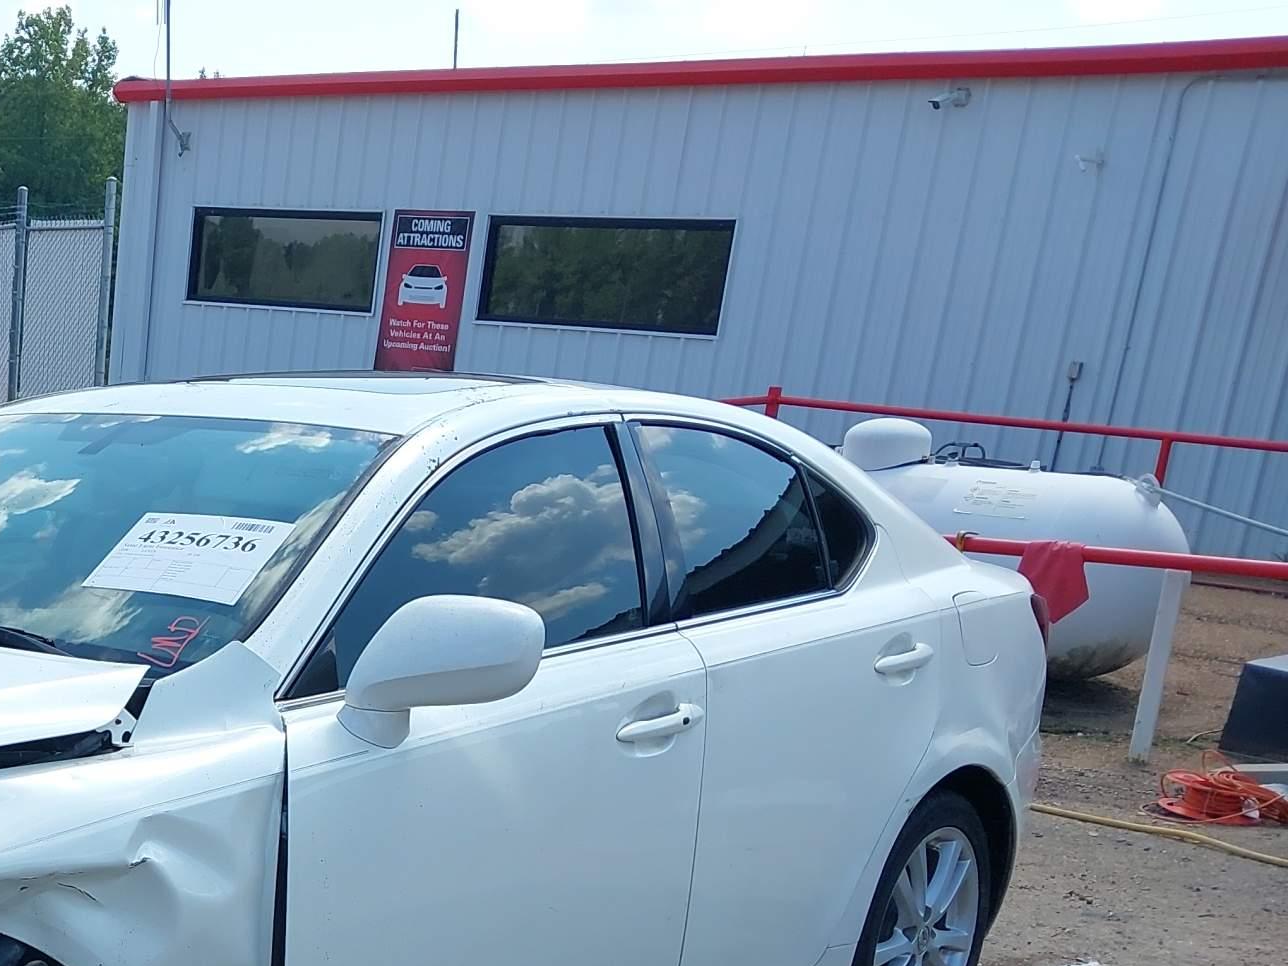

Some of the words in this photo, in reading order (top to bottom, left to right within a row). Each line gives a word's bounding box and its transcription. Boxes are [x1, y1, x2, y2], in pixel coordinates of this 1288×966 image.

[412, 219, 452, 233] COMING
[397, 233, 464, 247] ATTRACTIONS
[389, 318, 411, 327] Watch
[413, 320, 425, 328] For
[427, 321, 449, 330] These
[390, 329, 421, 339] Vehicles
[422, 331, 433, 340] At
[434, 332, 446, 341] An
[383, 339, 418, 351] Upcoming
[418, 342, 451, 352] Auction!
[139, 530, 261, 553] 43256736
